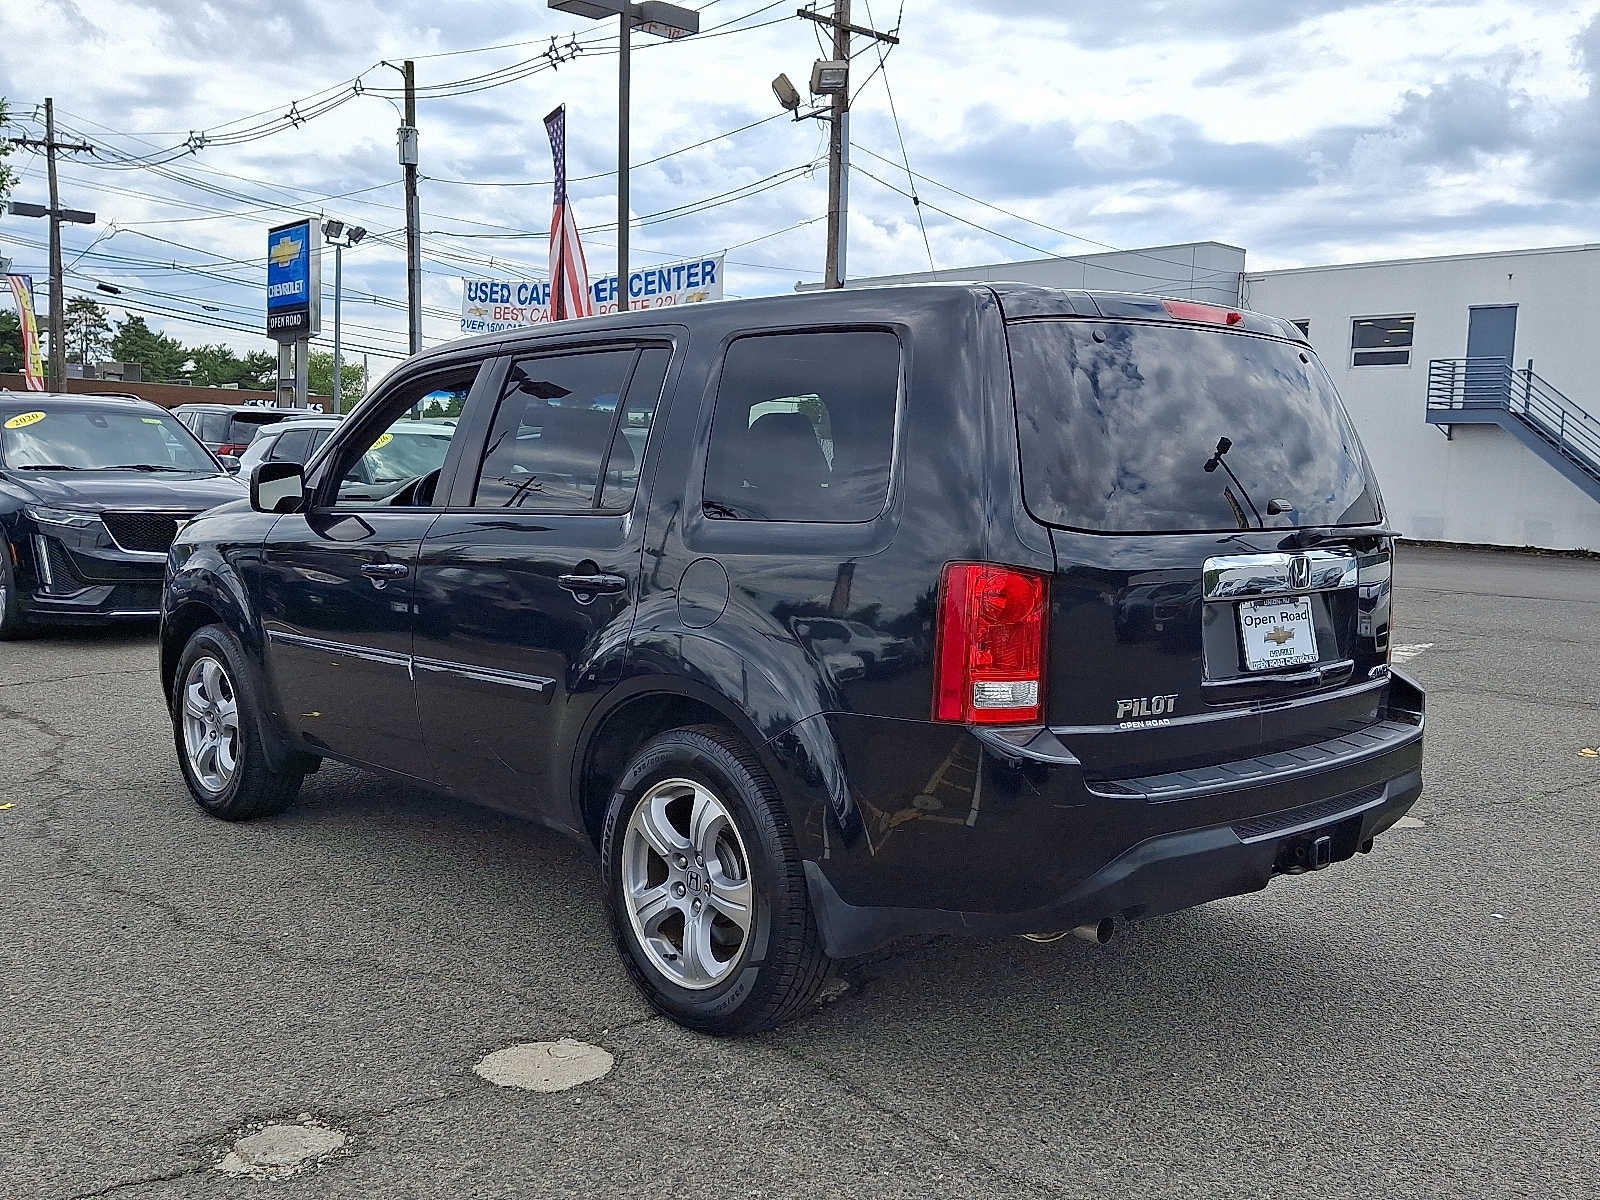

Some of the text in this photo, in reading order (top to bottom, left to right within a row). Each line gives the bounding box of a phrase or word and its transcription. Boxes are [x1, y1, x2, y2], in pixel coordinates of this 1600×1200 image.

[268, 280, 303, 298] CHEVROLET
[468, 282, 511, 303] USED
[630, 260, 716, 297] CENTER
[271, 314, 302, 328] OPEN ROAD
[493, 306, 527, 321] BEST
[1244, 610, 1307, 629] Open Road
[1117, 694, 1178, 718] PILOT
[1120, 718, 1170, 729] OPEN ROAD
